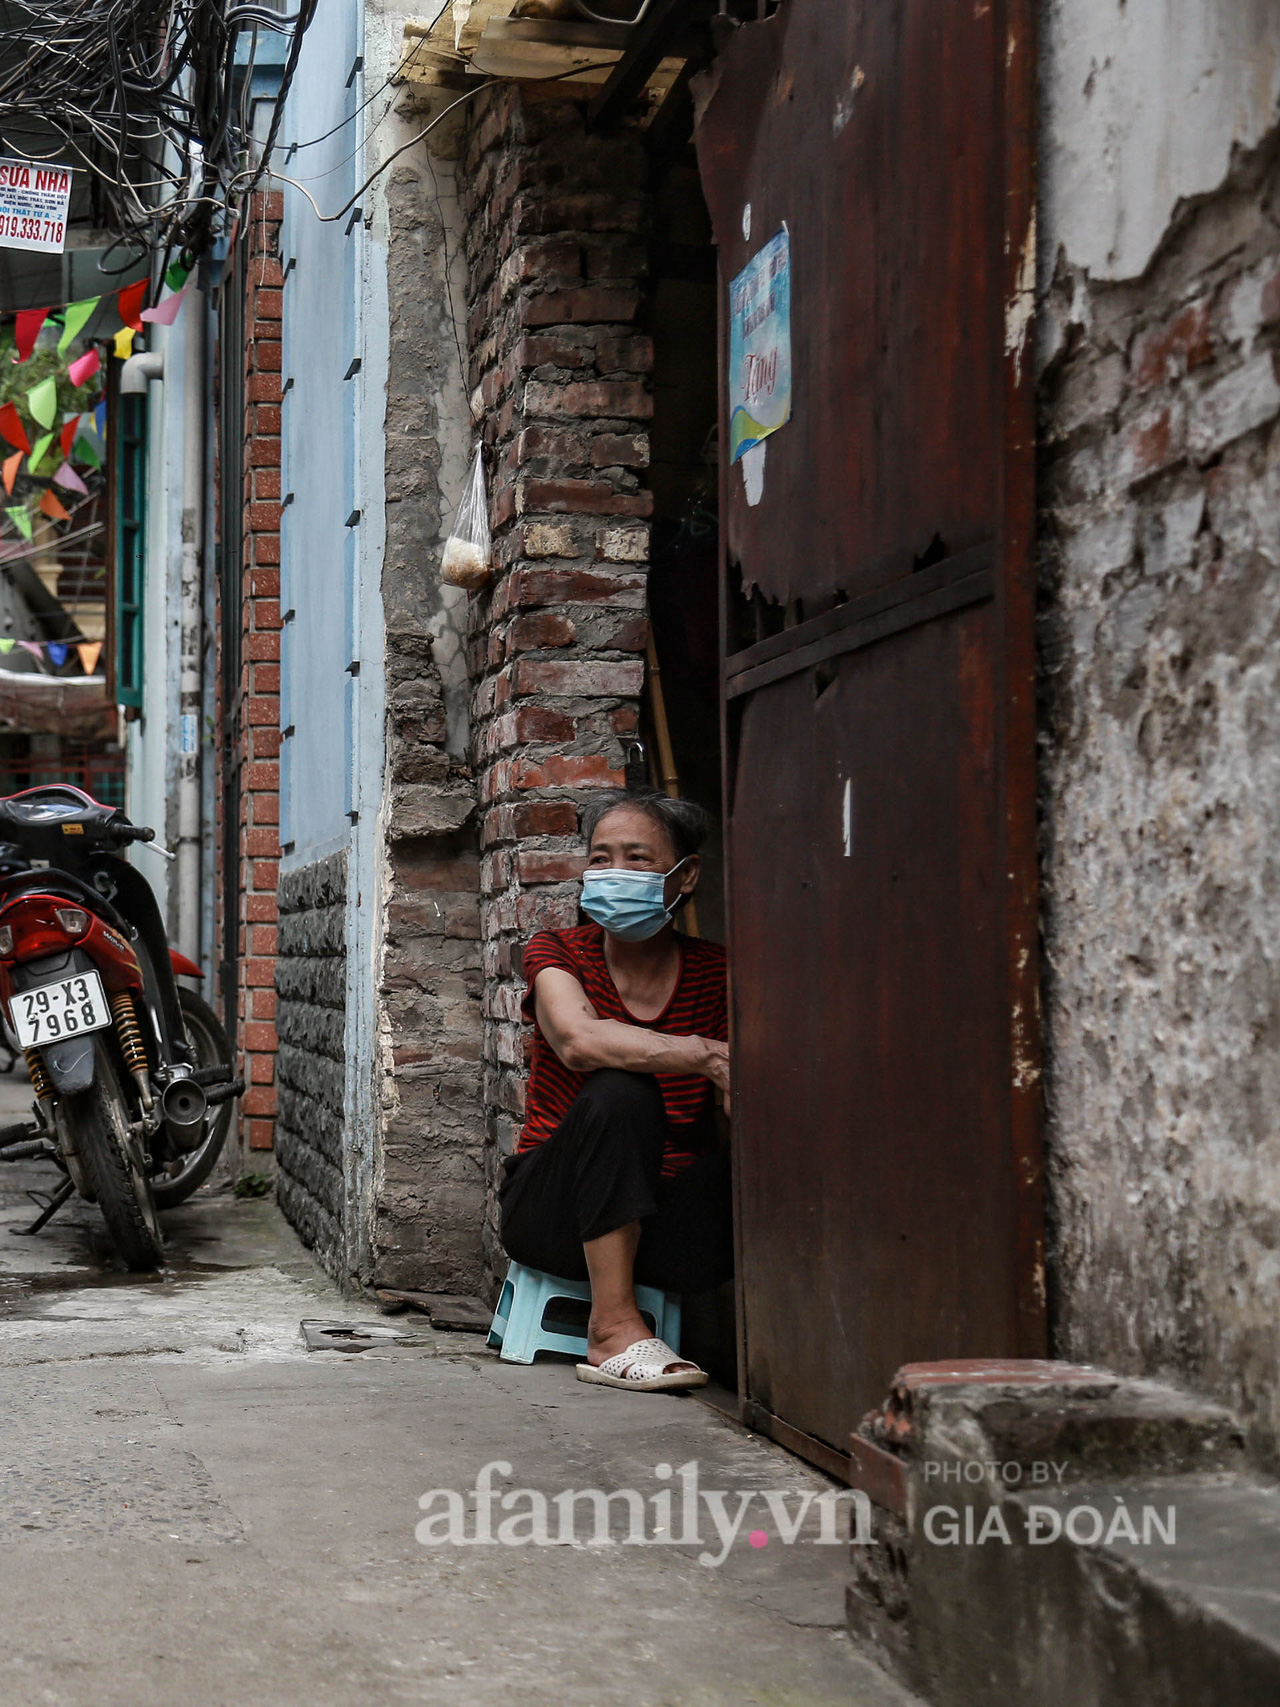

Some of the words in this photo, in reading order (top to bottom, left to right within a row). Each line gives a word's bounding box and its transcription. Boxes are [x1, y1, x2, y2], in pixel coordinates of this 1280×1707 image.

[35, 168, 68, 194] NHÀ
[12, 207, 30, 216] THẤT
[22, 978, 90, 1018] 29-X3
[28, 1002, 97, 1042] 7968
